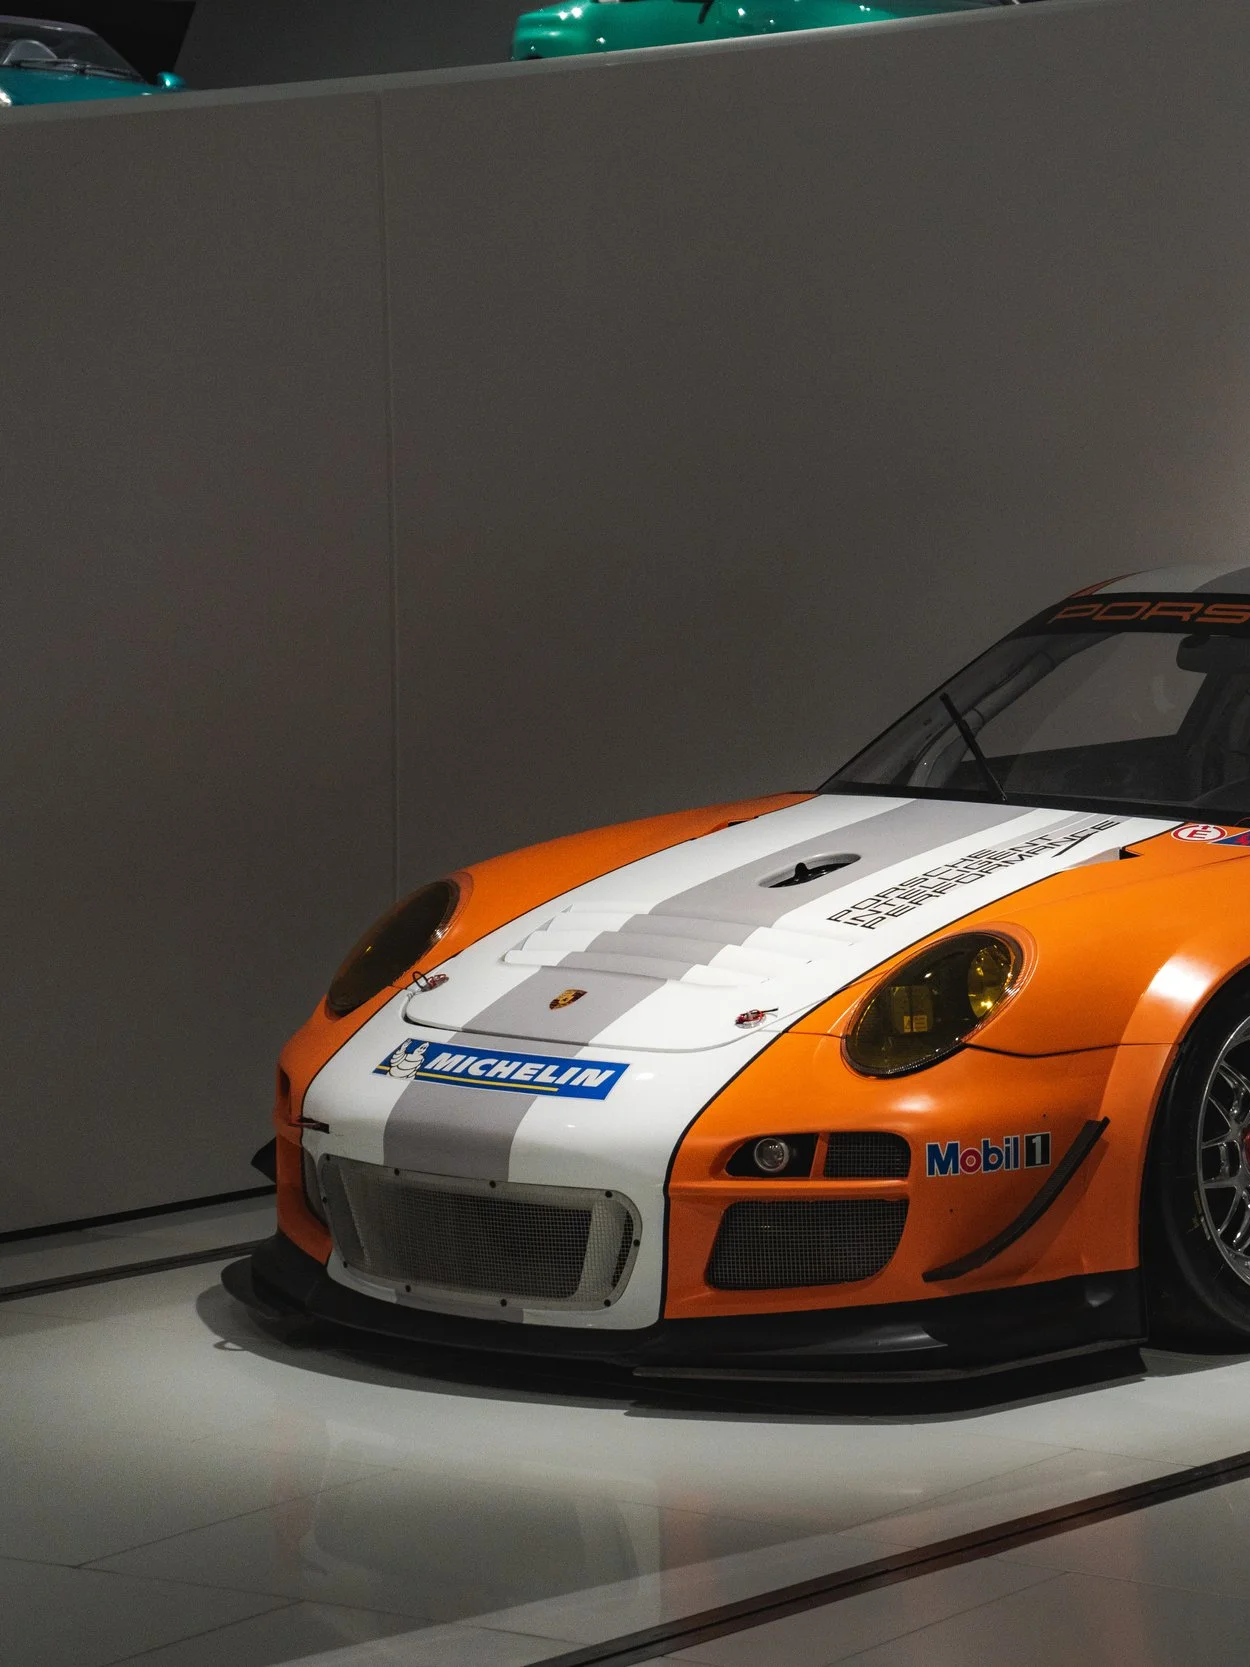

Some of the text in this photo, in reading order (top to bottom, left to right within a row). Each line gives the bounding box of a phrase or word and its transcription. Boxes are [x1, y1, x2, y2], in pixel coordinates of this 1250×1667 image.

[826, 848, 994, 923] PORSCHE
[843, 834, 1054, 926] INTELLIGENT
[860, 820, 1121, 930] PERFORMANCE
[424, 1052, 615, 1089] MICHELIN
[926, 1135, 1020, 1177] Mobil
